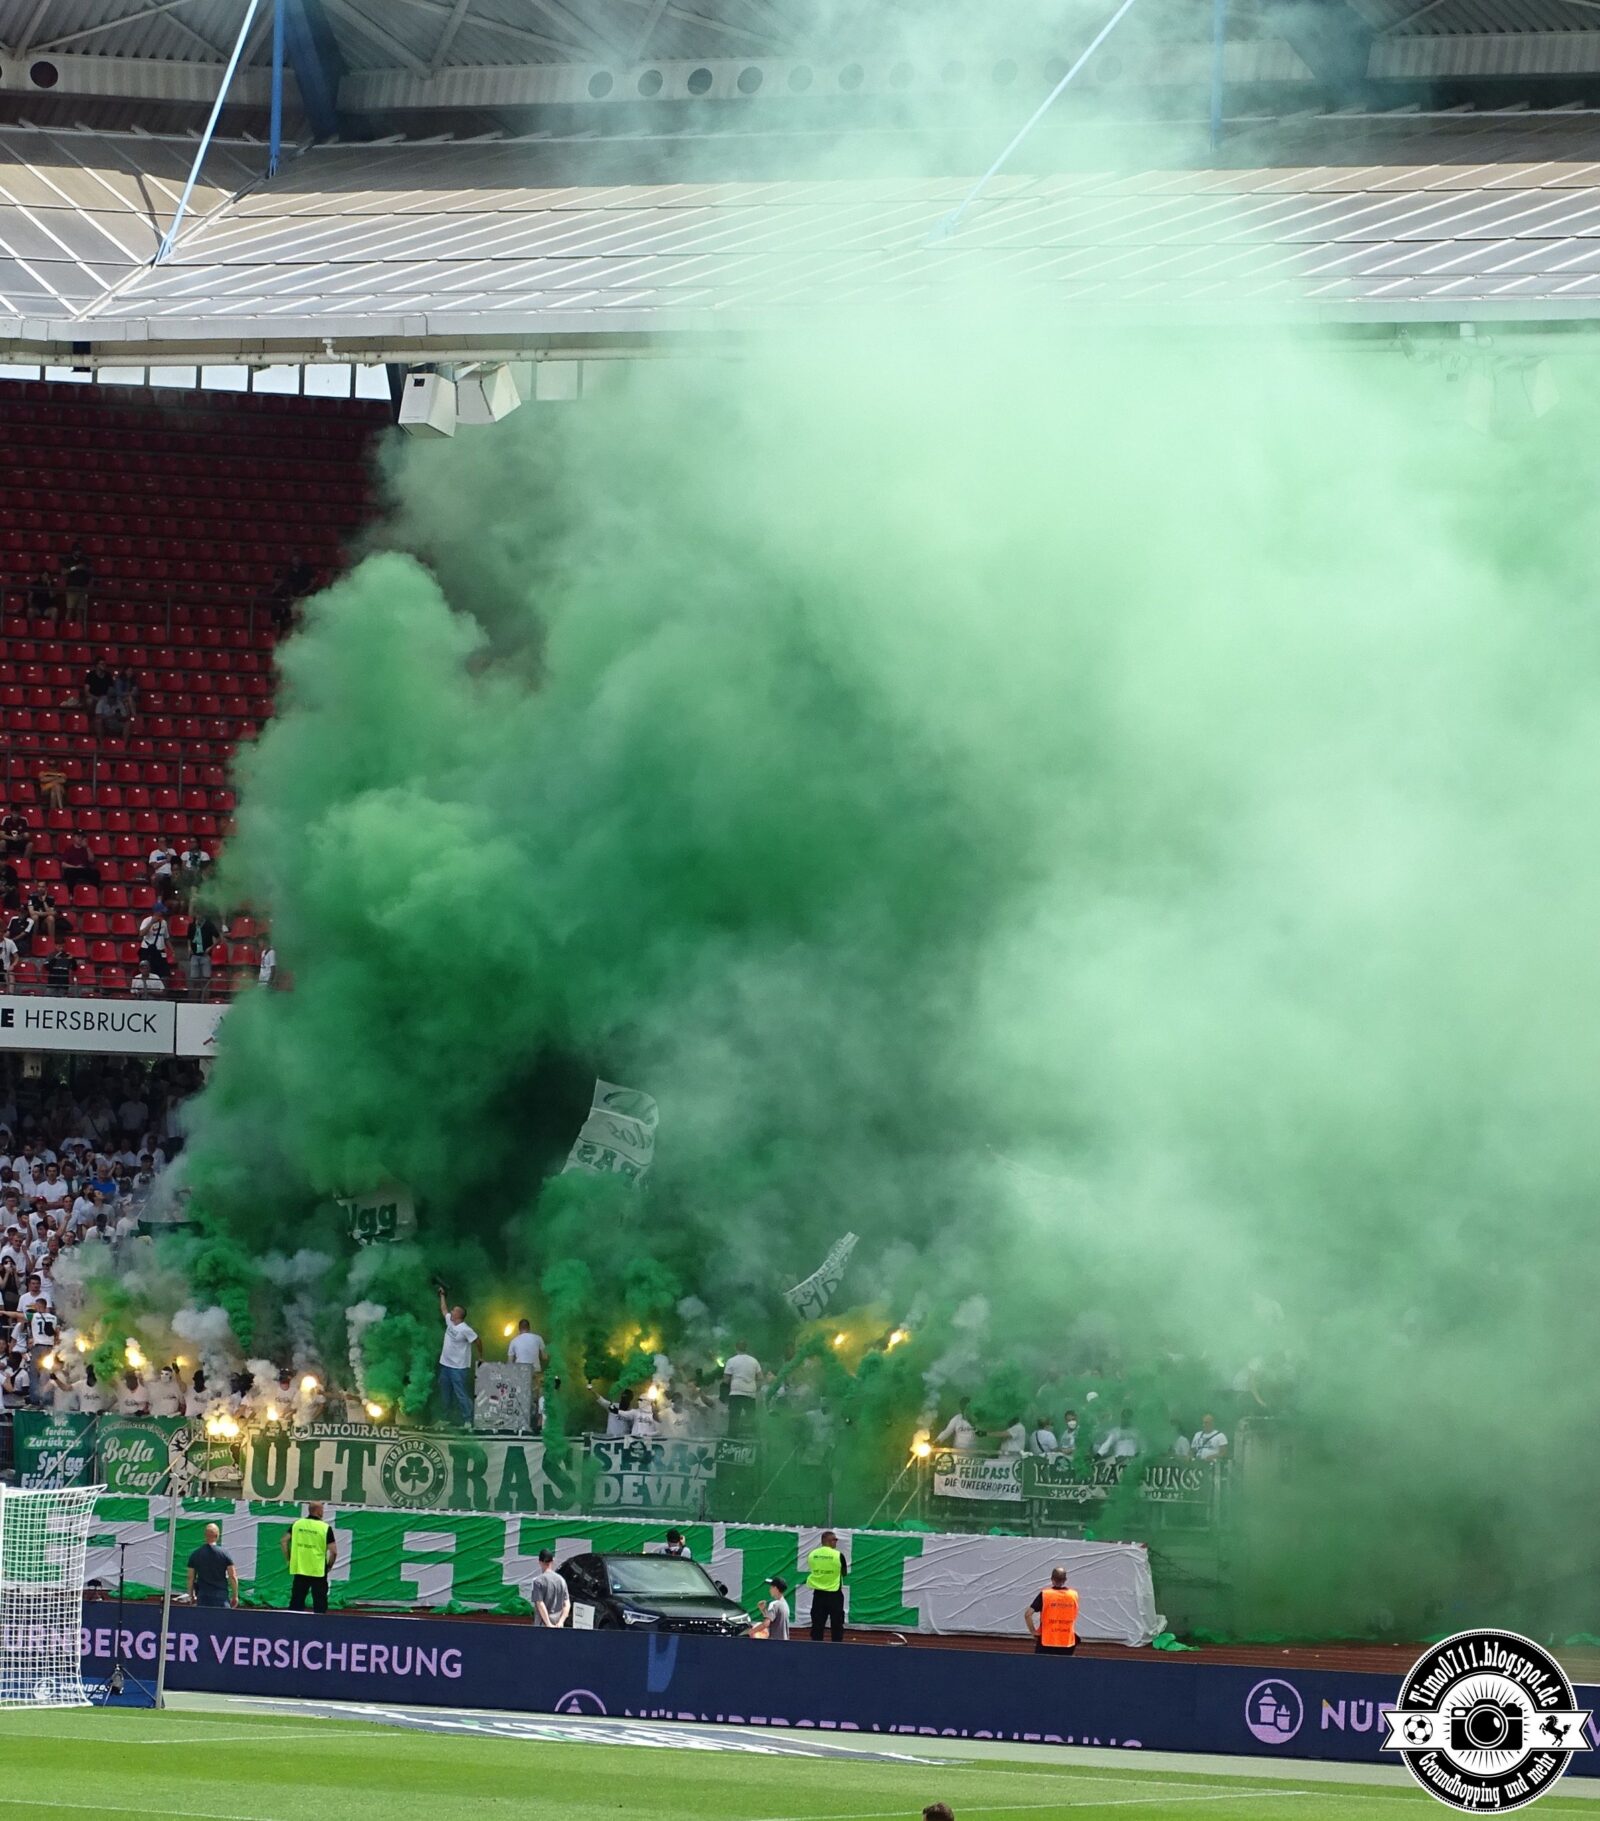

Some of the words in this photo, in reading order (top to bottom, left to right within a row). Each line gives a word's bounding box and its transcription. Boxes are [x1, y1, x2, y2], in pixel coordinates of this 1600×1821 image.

[25, 1009, 157, 1033] HERSBRUCK
[27, 1437, 63, 1447] Zurück
[313, 1423, 399, 1438] ENTOURAGE
[101, 1437, 155, 1463] Bella
[37, 1451, 84, 1478] SpVgg
[115, 1463, 161, 1487] Ciao
[959, 1466, 1010, 1480] FEHLPASS
[593, 1475, 708, 1506] DEVIA
[944, 1477, 958, 1488] DIE
[210, 1634, 462, 1678] VERSICHERUNG
